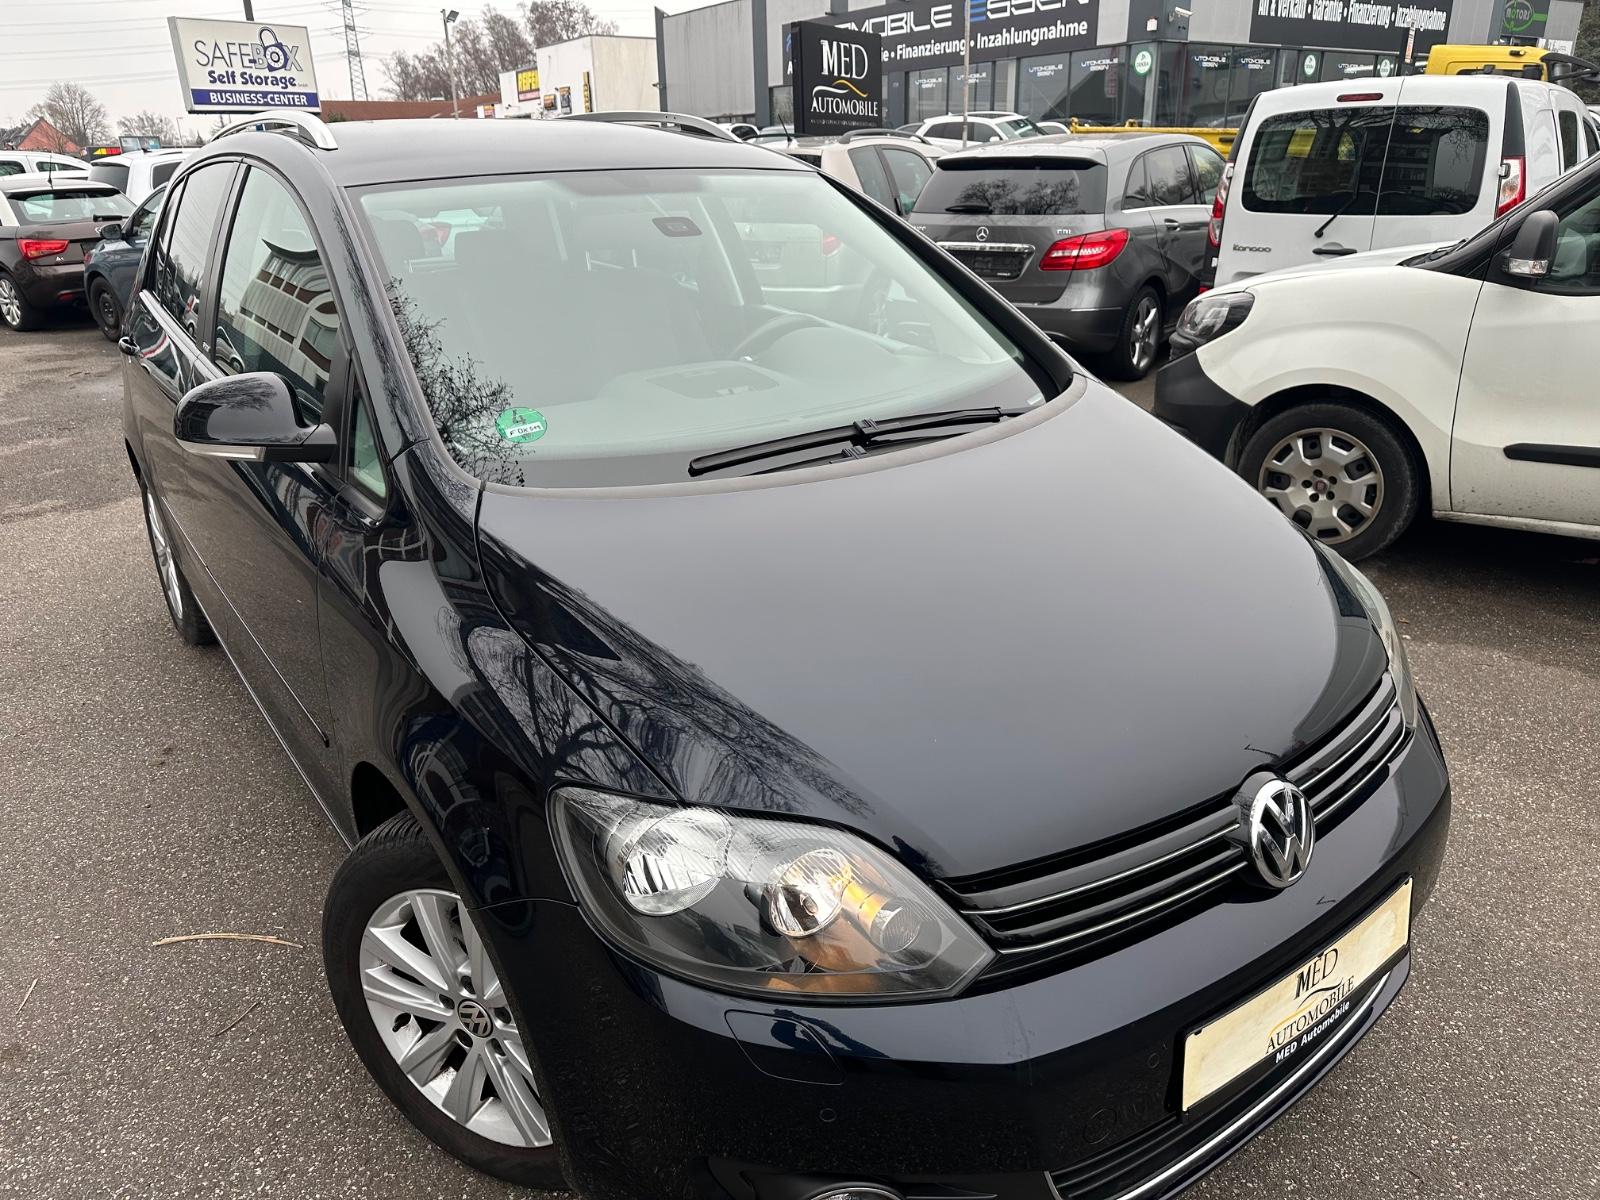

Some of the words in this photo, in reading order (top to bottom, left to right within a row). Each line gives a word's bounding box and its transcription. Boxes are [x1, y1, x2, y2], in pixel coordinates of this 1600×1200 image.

[1312, 0, 1343, 22] Garantie
[1348, 0, 1391, 28] Finanzierung
[1395, 4, 1446, 31] Inzahlungnahme
[1506, 8, 1530, 20] MOTORS
[896, 39, 966, 60] Finanzierung
[977, 20, 1088, 48] Inzahlungnahme
[820, 39, 868, 80] MED
[208, 70, 236, 84] Self
[240, 71, 297, 89] Storage
[209, 92, 307, 105] BUSINESS-CENTER
[811, 96, 878, 117] AUTOMOBILE
[1294, 948, 1339, 1000] MED
[1265, 975, 1355, 1055] AUTOMOBILE
[1275, 1041, 1298, 1064] MED
[1301, 1001, 1350, 1046] Automobile
